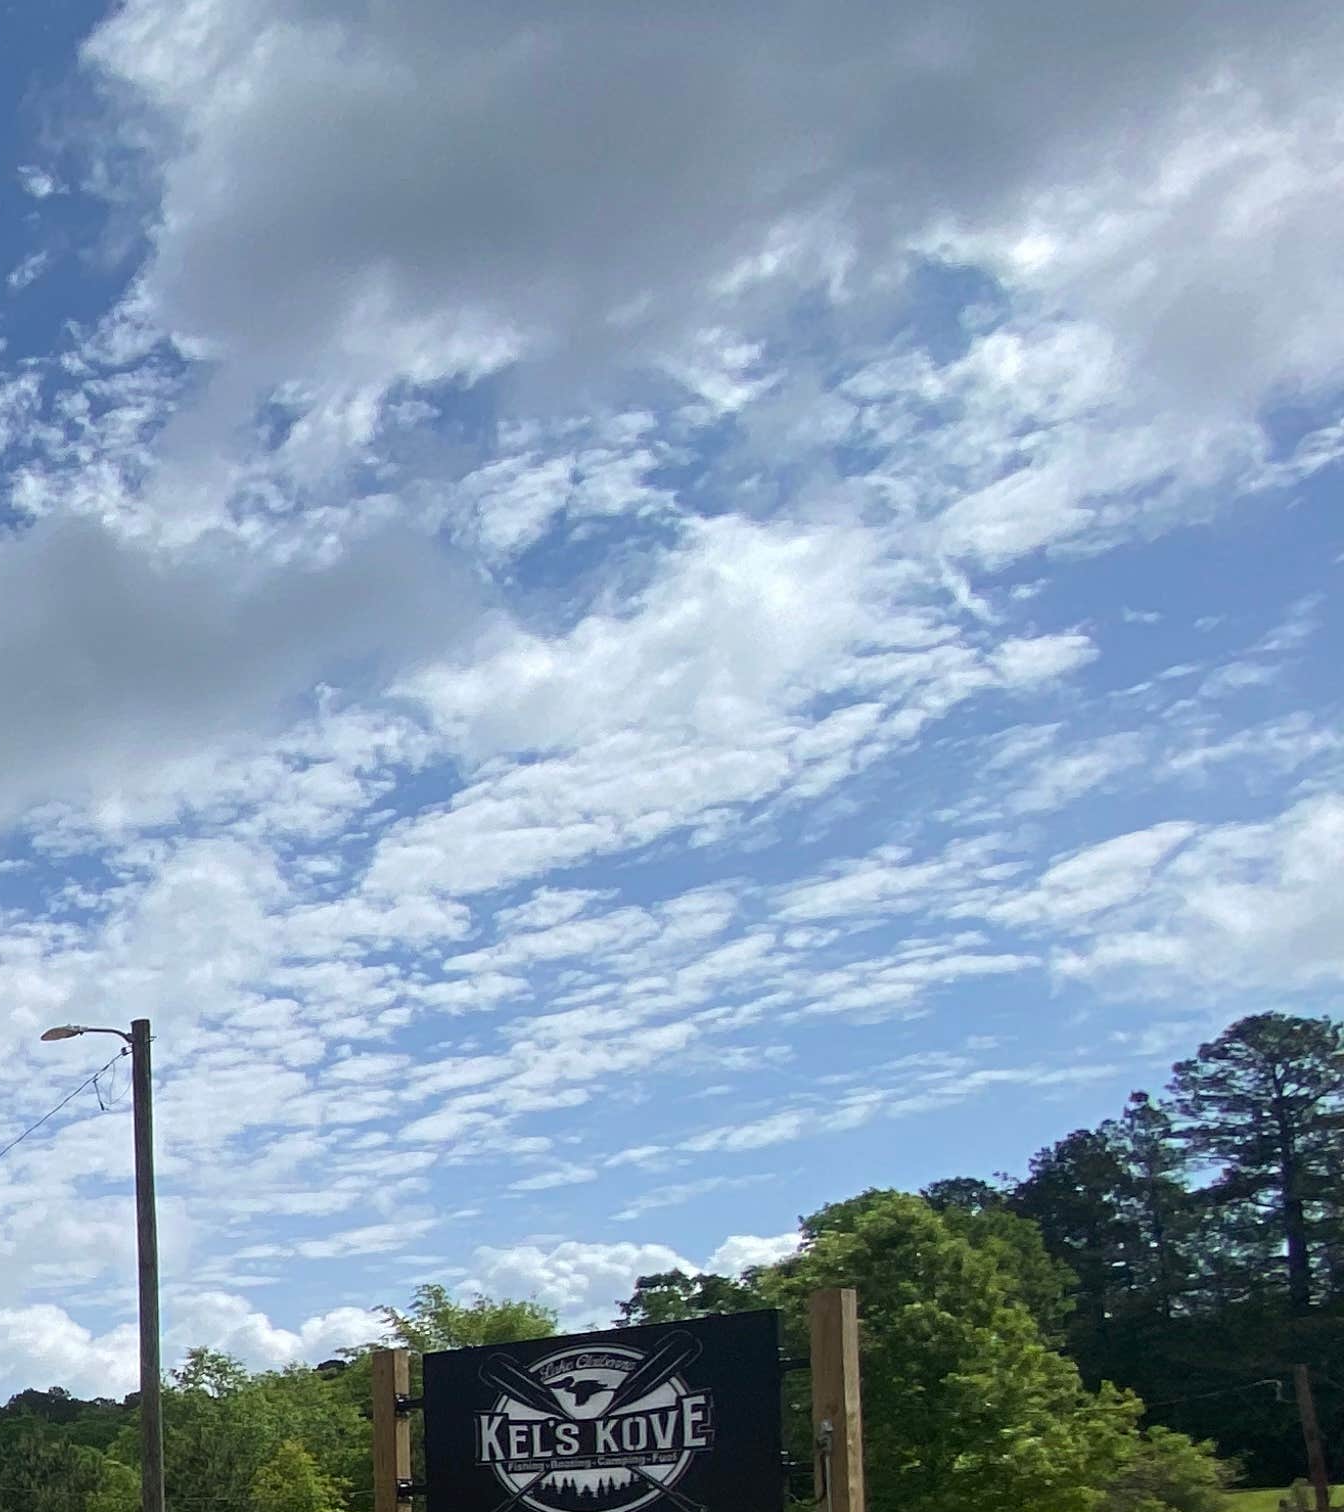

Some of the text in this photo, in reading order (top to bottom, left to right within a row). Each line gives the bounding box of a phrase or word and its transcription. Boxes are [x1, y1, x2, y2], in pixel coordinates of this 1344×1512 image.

[480, 1395, 707, 1462] KEL'S KOVE
[597, 1453, 646, 1466] Camping
